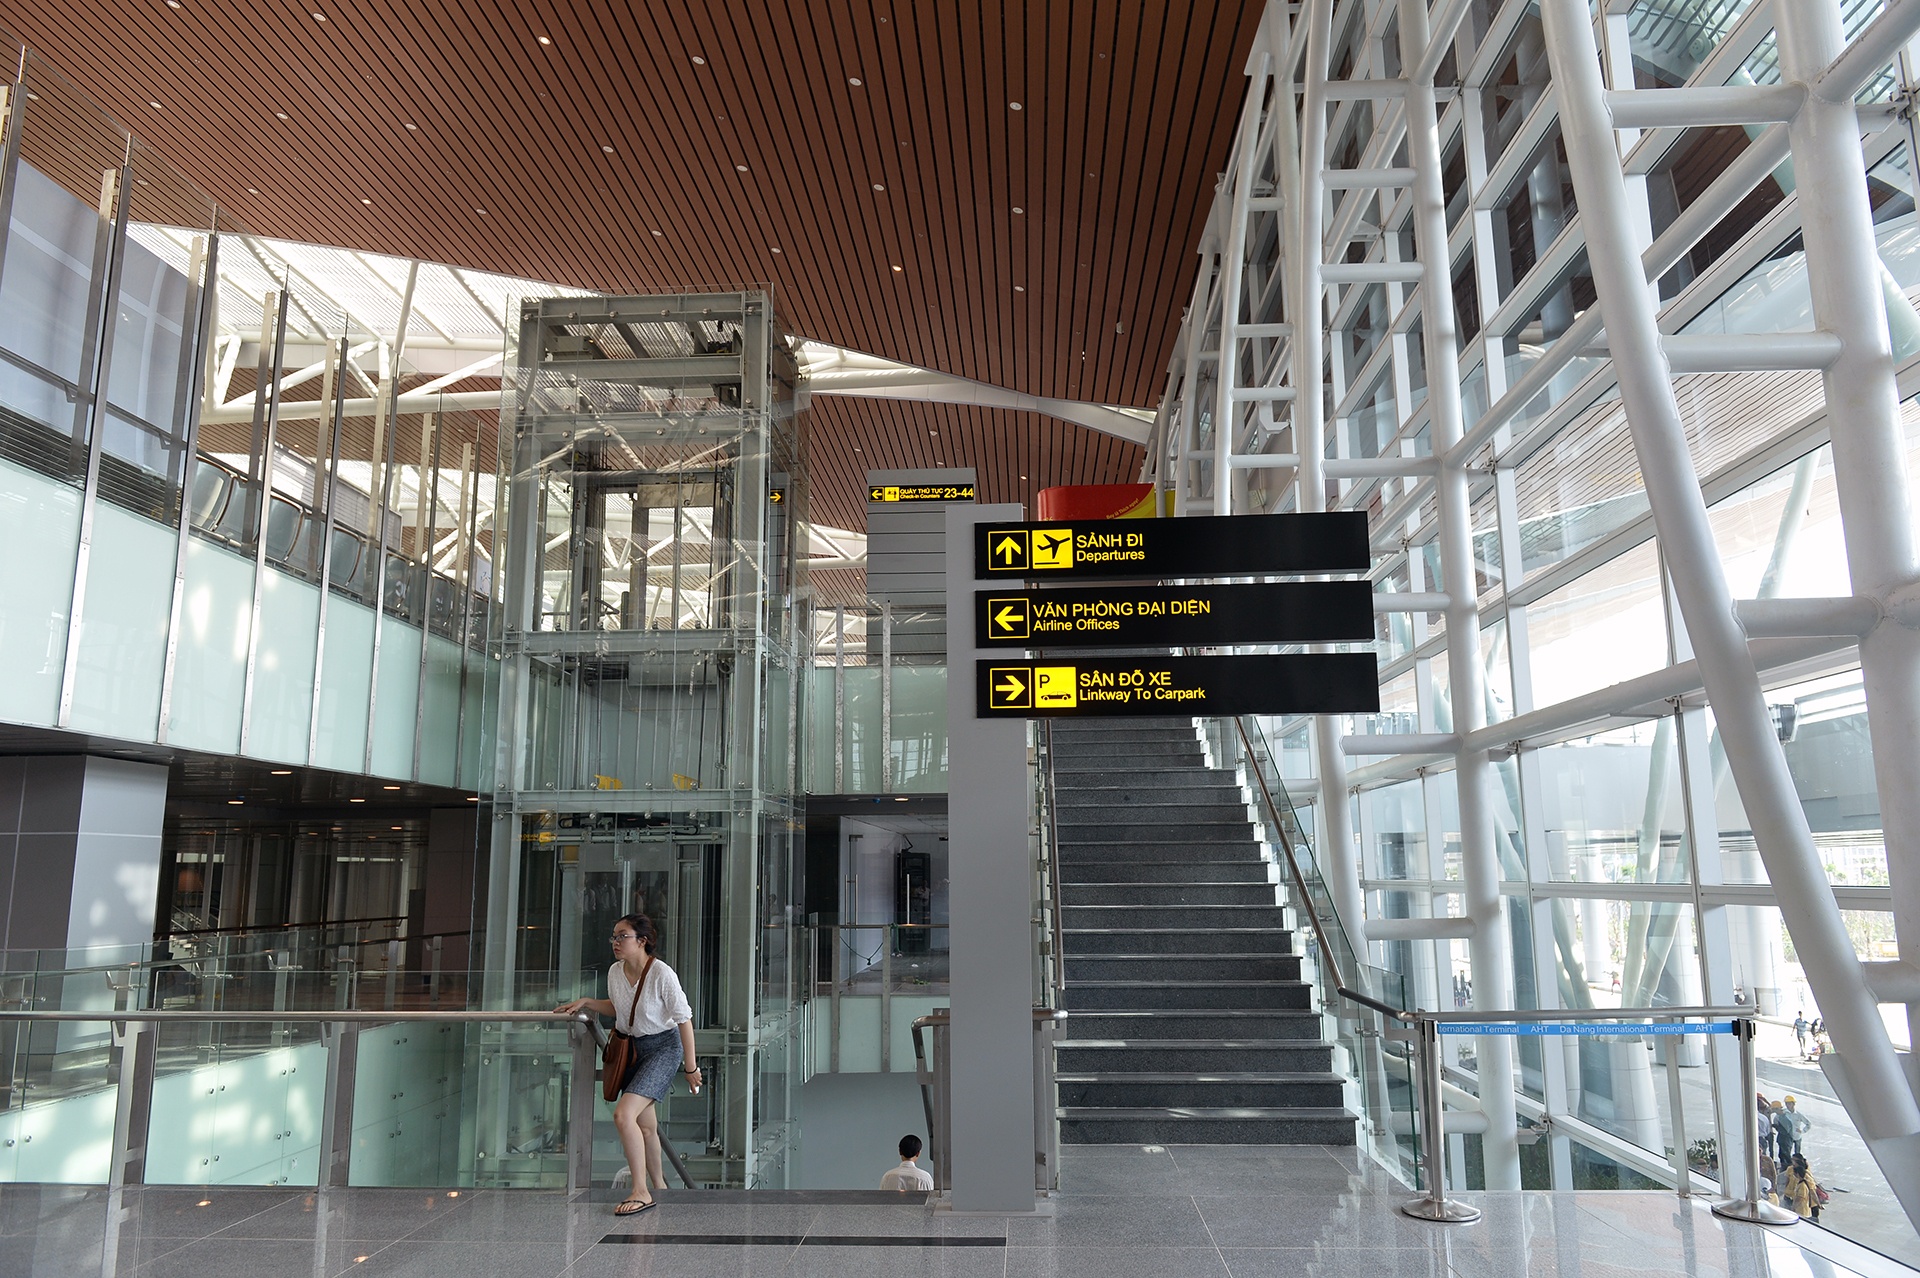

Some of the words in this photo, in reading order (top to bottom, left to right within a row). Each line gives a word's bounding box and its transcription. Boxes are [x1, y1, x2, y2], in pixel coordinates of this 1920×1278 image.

[944, 488, 974, 498] 23-44
[1076, 532, 1122, 548] SẢNH
[1126, 533, 1143, 547] ĐI
[1076, 550, 1145, 564] Departures
[1033, 601, 1067, 617] VĂN
[1072, 600, 1134, 617] PHÒNG
[1137, 601, 1166, 617] ĐẠI
[1170, 599, 1211, 617] DIỆN
[1033, 618, 1073, 631] Airline
[1076, 618, 1120, 631] Offices
[1039, 674, 1051, 689] P
[1080, 670, 1114, 687] SÂN
[1118, 669, 1145, 687] ĐỖ
[1148, 671, 1172, 686] XE
[1080, 688, 1131, 703] Linkway
[1134, 688, 1152, 700] To
[1154, 687, 1206, 702] Carpark
[1439, 1025, 1482, 1033] ternational
[1483, 1025, 1520, 1033] Terminal
[1530, 1025, 1550, 1033] AHT
[1559, 1025, 1572, 1033] Da
[1573, 1025, 1596, 1035] Nang
[1596, 1025, 1647, 1033] International
[1648, 1024, 1685, 1033] Terminal
[1695, 1024, 1715, 1032] AHT
